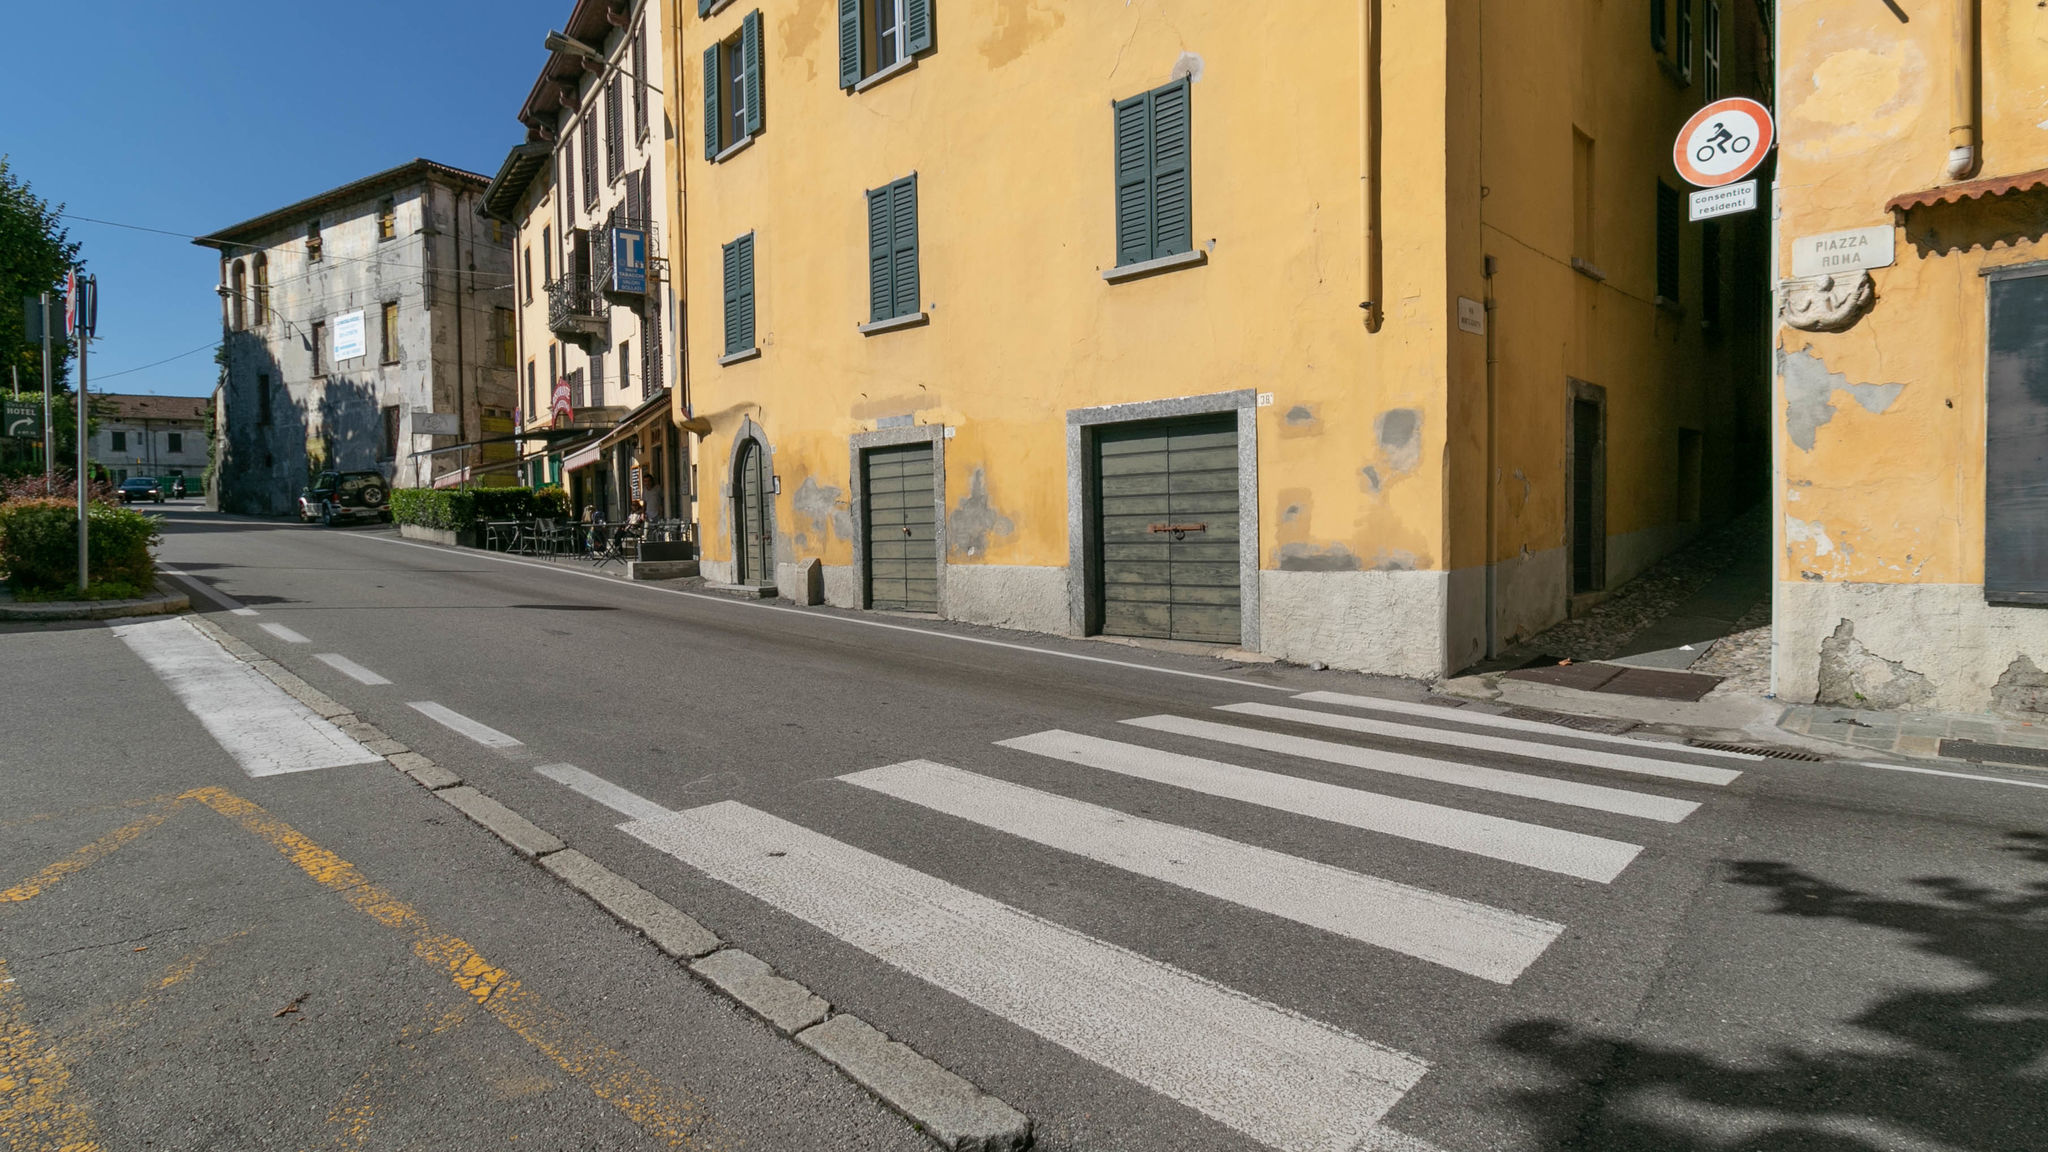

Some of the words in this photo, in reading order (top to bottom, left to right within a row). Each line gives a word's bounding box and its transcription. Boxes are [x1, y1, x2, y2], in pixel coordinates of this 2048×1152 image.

[1695, 188, 1751, 204] consentito
[1699, 199, 1746, 215] residenti
[620, 232, 640, 268] T
[1816, 235, 1868, 253] PIAZZA
[1822, 252, 1861, 267] ROMA
[6, 407, 36, 416] HOTEL
